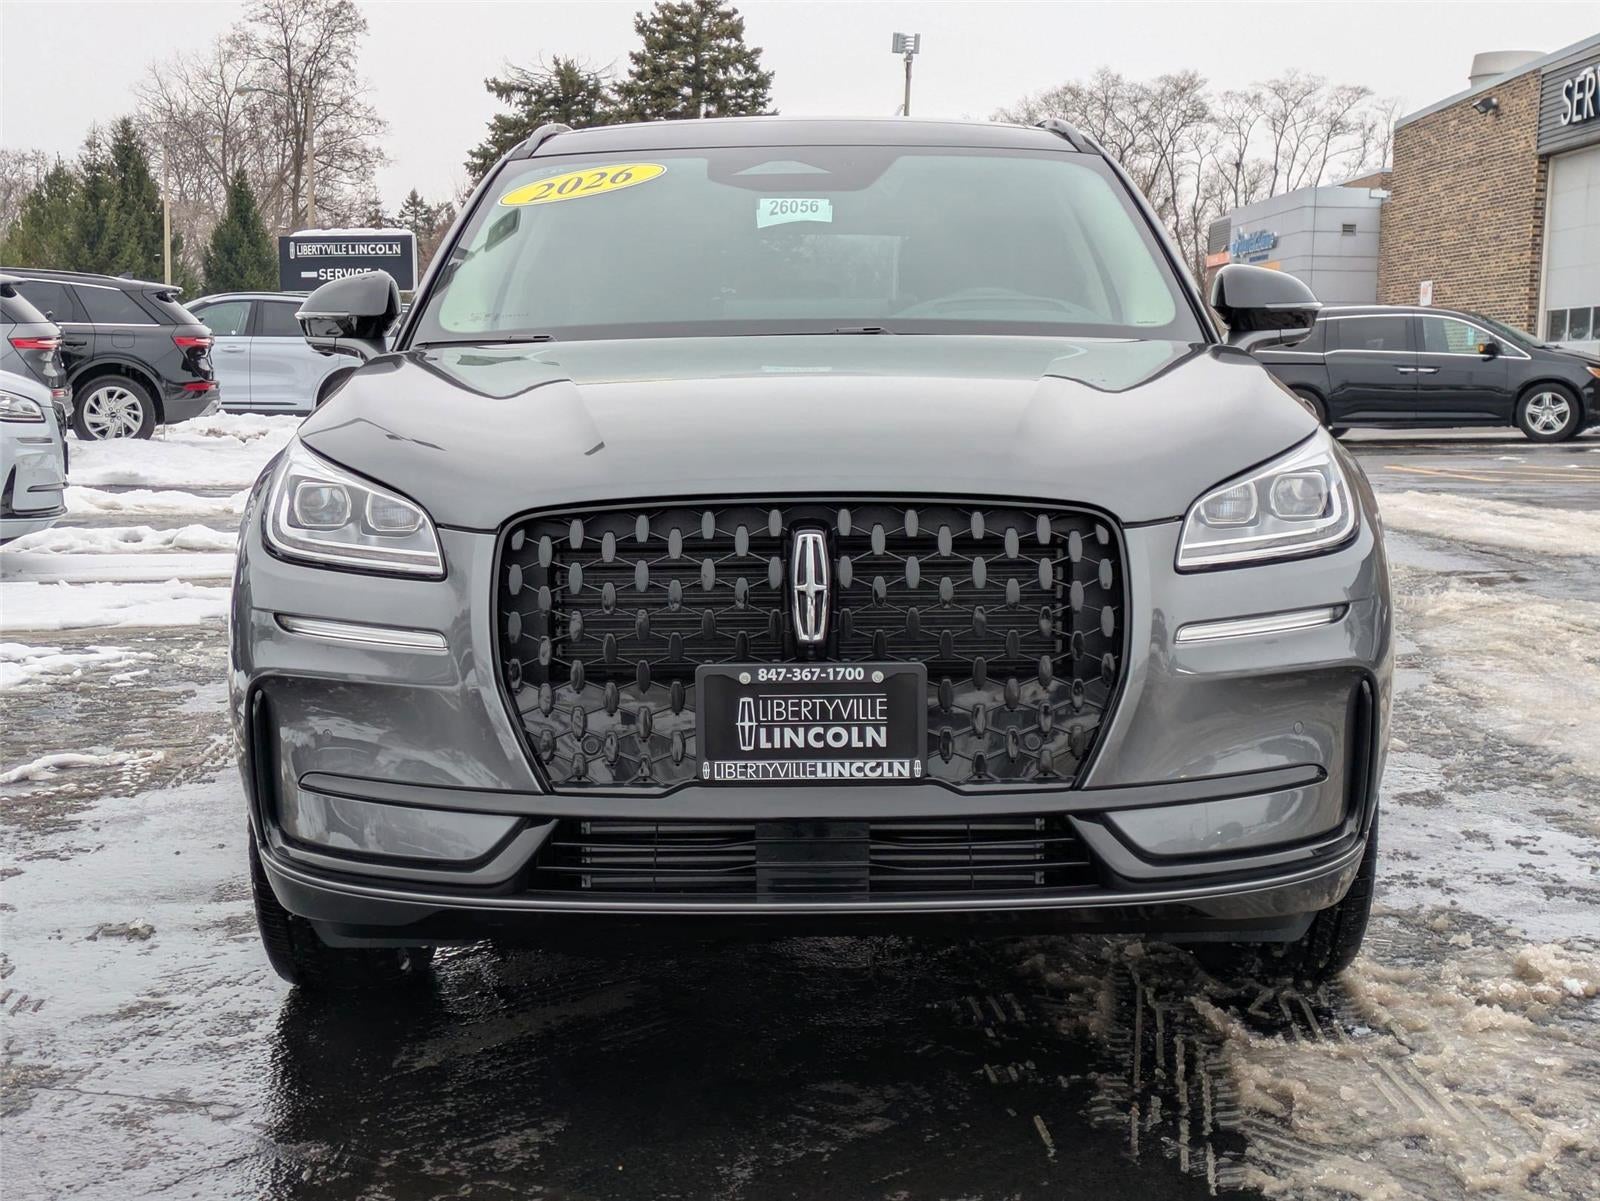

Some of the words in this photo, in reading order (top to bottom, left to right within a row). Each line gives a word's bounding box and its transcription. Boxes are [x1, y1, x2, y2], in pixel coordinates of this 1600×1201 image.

[1561, 66, 1600, 125] SER
[527, 166, 634, 202] 2026
[769, 199, 820, 216] 26056
[296, 243, 346, 256] LIBERTYVILLE
[348, 244, 401, 255] LINCOLN
[758, 667, 865, 682] 847-367-1700
[759, 698, 888, 721] LIBERTYVILLE
[759, 726, 887, 749] LINCOLN
